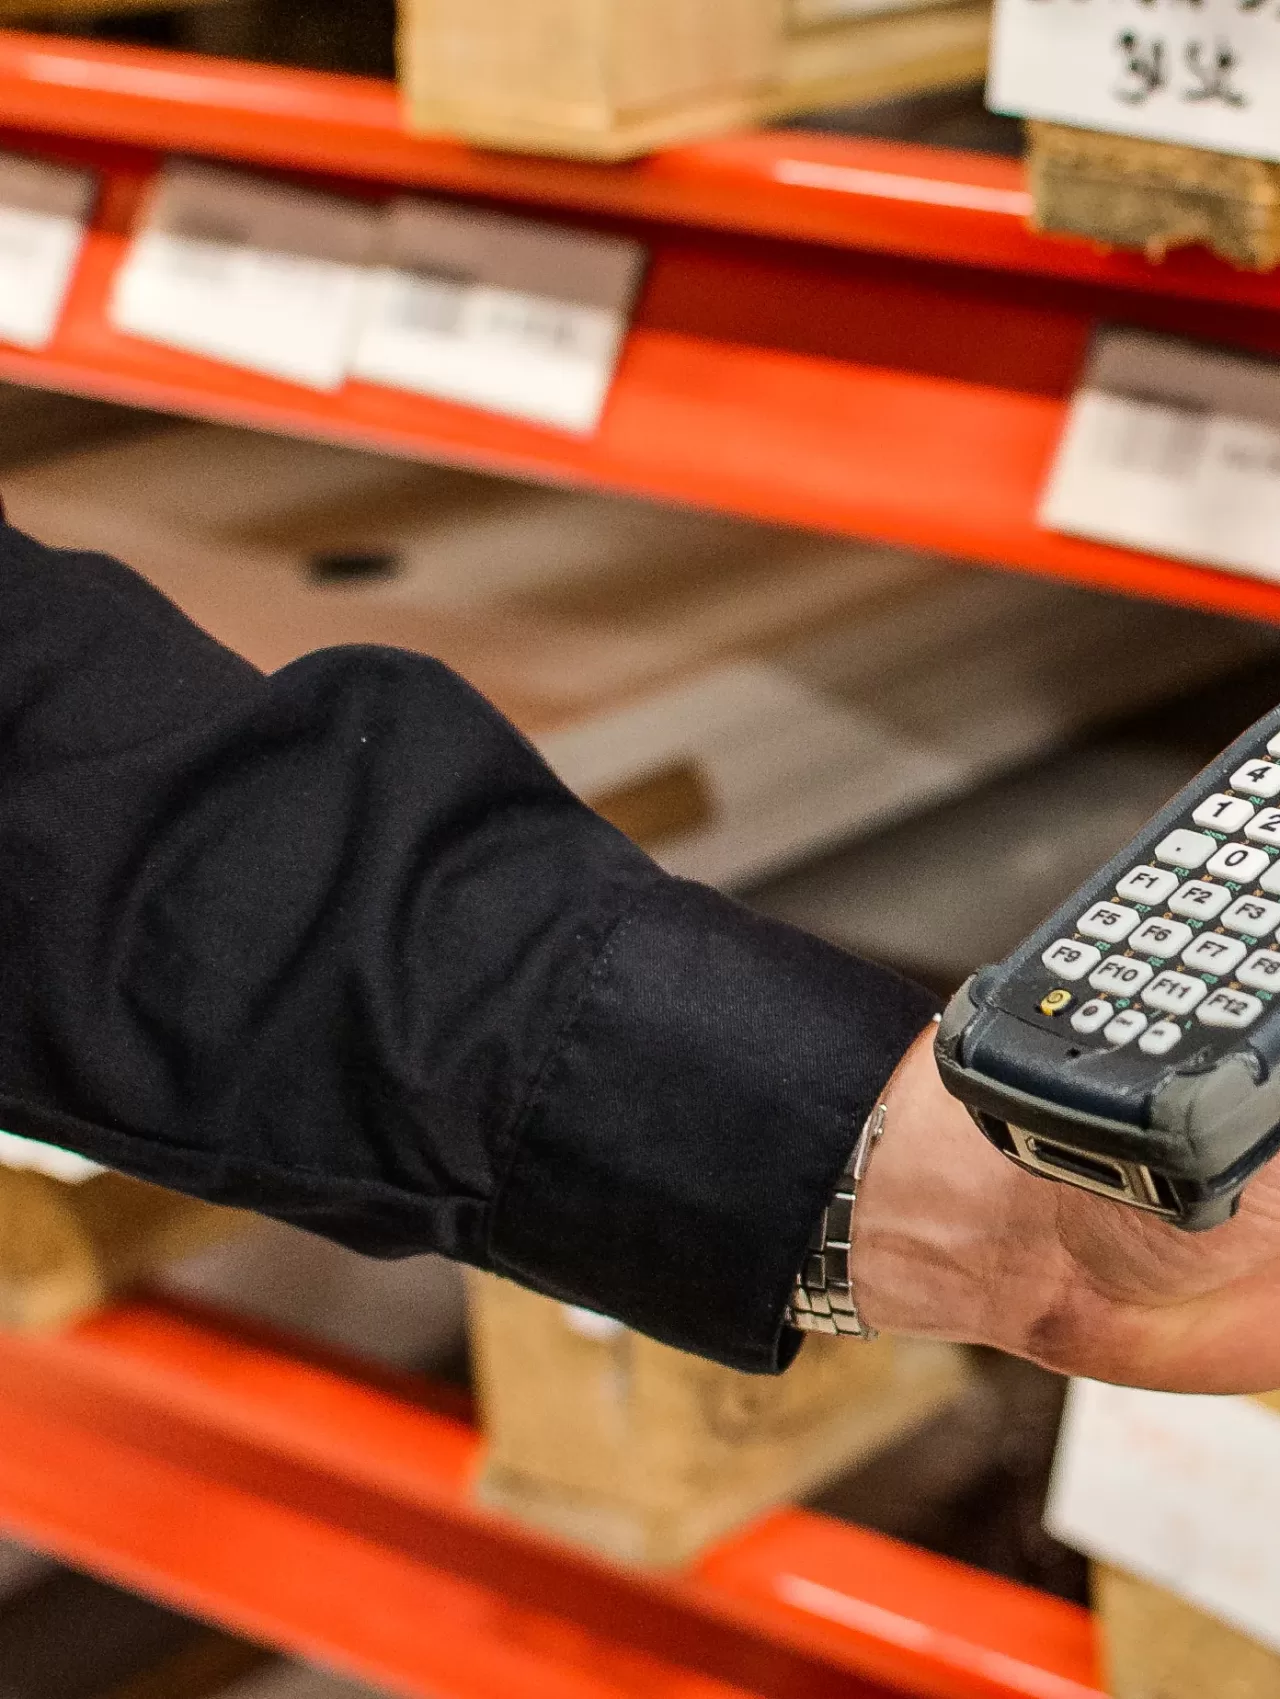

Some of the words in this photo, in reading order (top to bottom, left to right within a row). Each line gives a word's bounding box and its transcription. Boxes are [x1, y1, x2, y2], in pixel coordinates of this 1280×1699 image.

[1245, 765, 1273, 784] 4
[1212, 800, 1234, 819] 1
[1223, 849, 1250, 868] 0
[1127, 871, 1160, 890] F1
[1181, 887, 1214, 905] F2
[1088, 909, 1122, 927] F5
[1234, 902, 1267, 921] F3
[1141, 925, 1173, 943] F6
[1051, 945, 1083, 964] F9
[1195, 939, 1230, 957] F7
[1098, 961, 1140, 983] F10
[1150, 978, 1192, 999] F11
[1206, 994, 1250, 1017] F12
